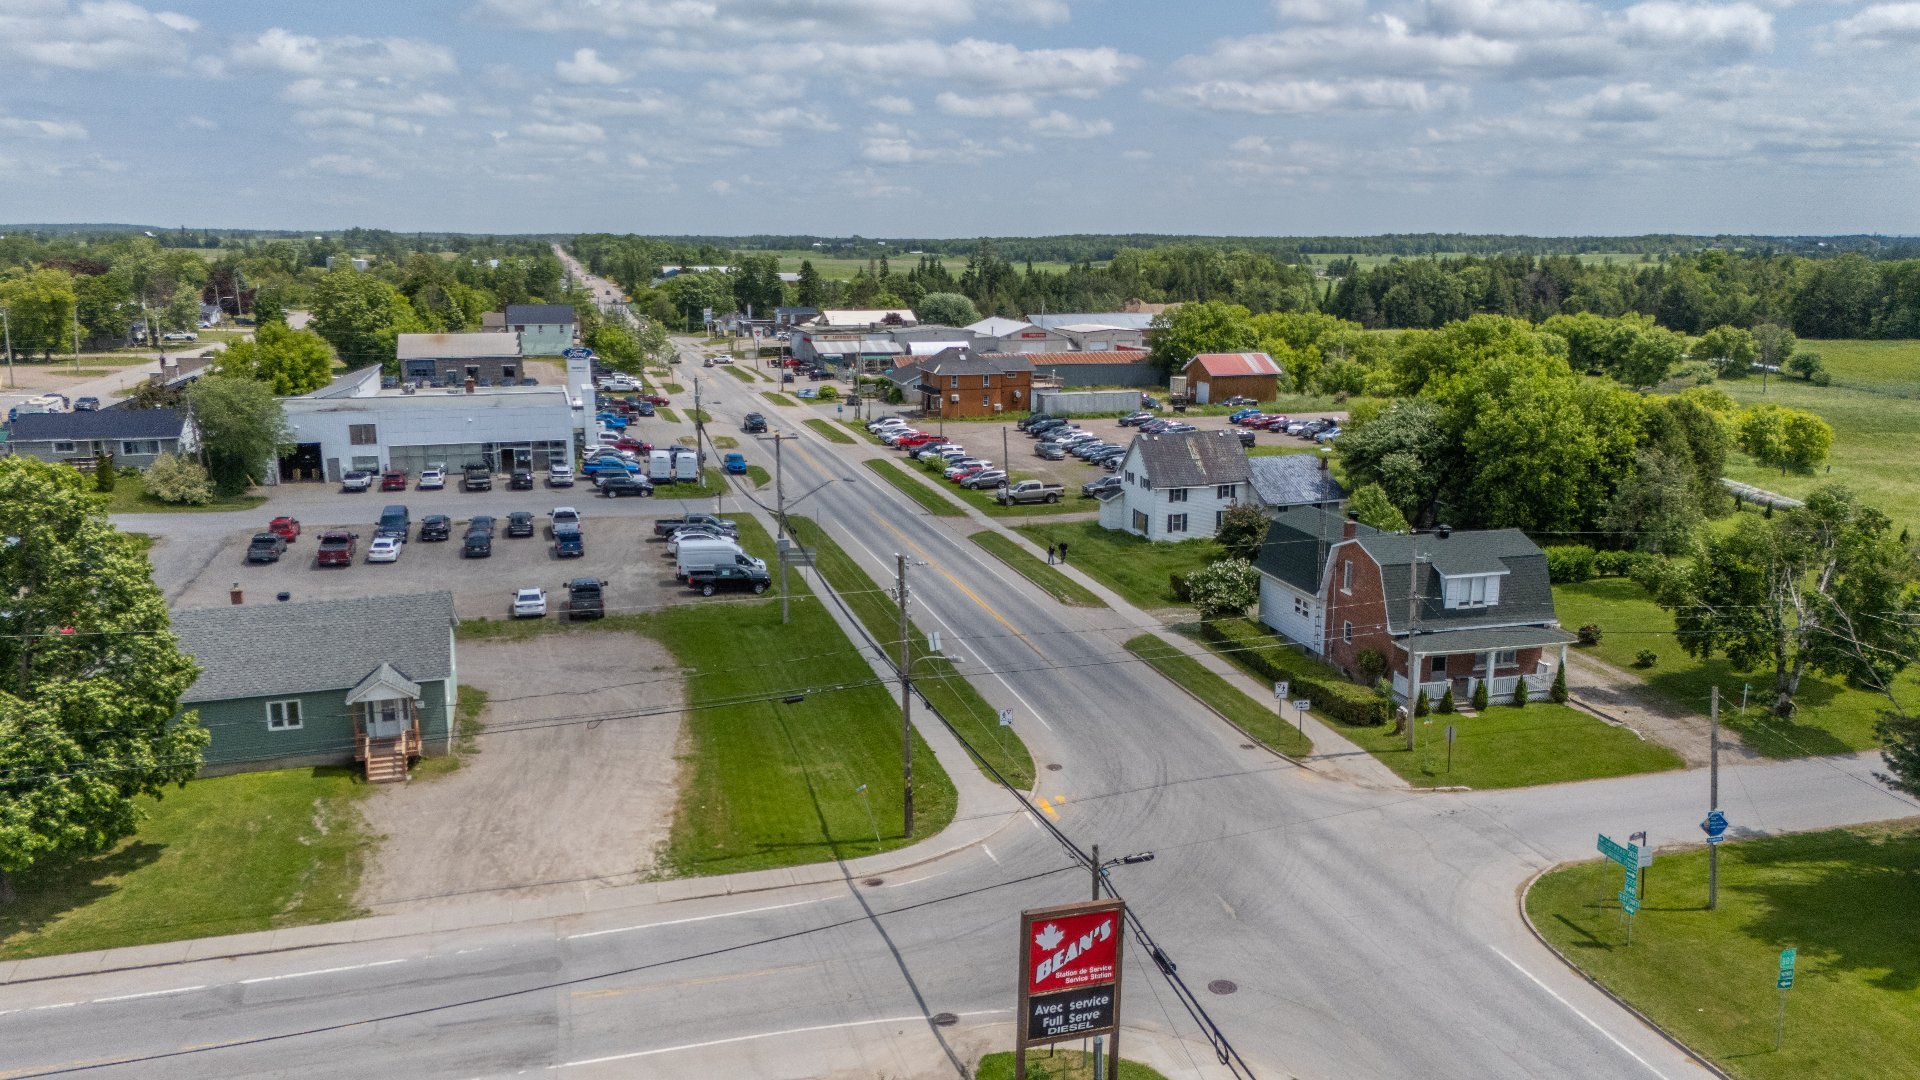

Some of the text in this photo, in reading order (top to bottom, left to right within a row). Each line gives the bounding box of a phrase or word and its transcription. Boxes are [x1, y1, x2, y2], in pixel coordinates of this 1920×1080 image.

[568, 350, 588, 358] Ford
[1035, 919, 1111, 984] BEAN'S
[1055, 970, 1078, 979] Station
[1089, 965, 1112, 973] Service
[1065, 972, 1112, 984] Service Station
[1034, 995, 1109, 1016] Avec service
[1042, 1010, 1100, 1028] Full Serve
[1047, 1021, 1094, 1035] DIESEL
